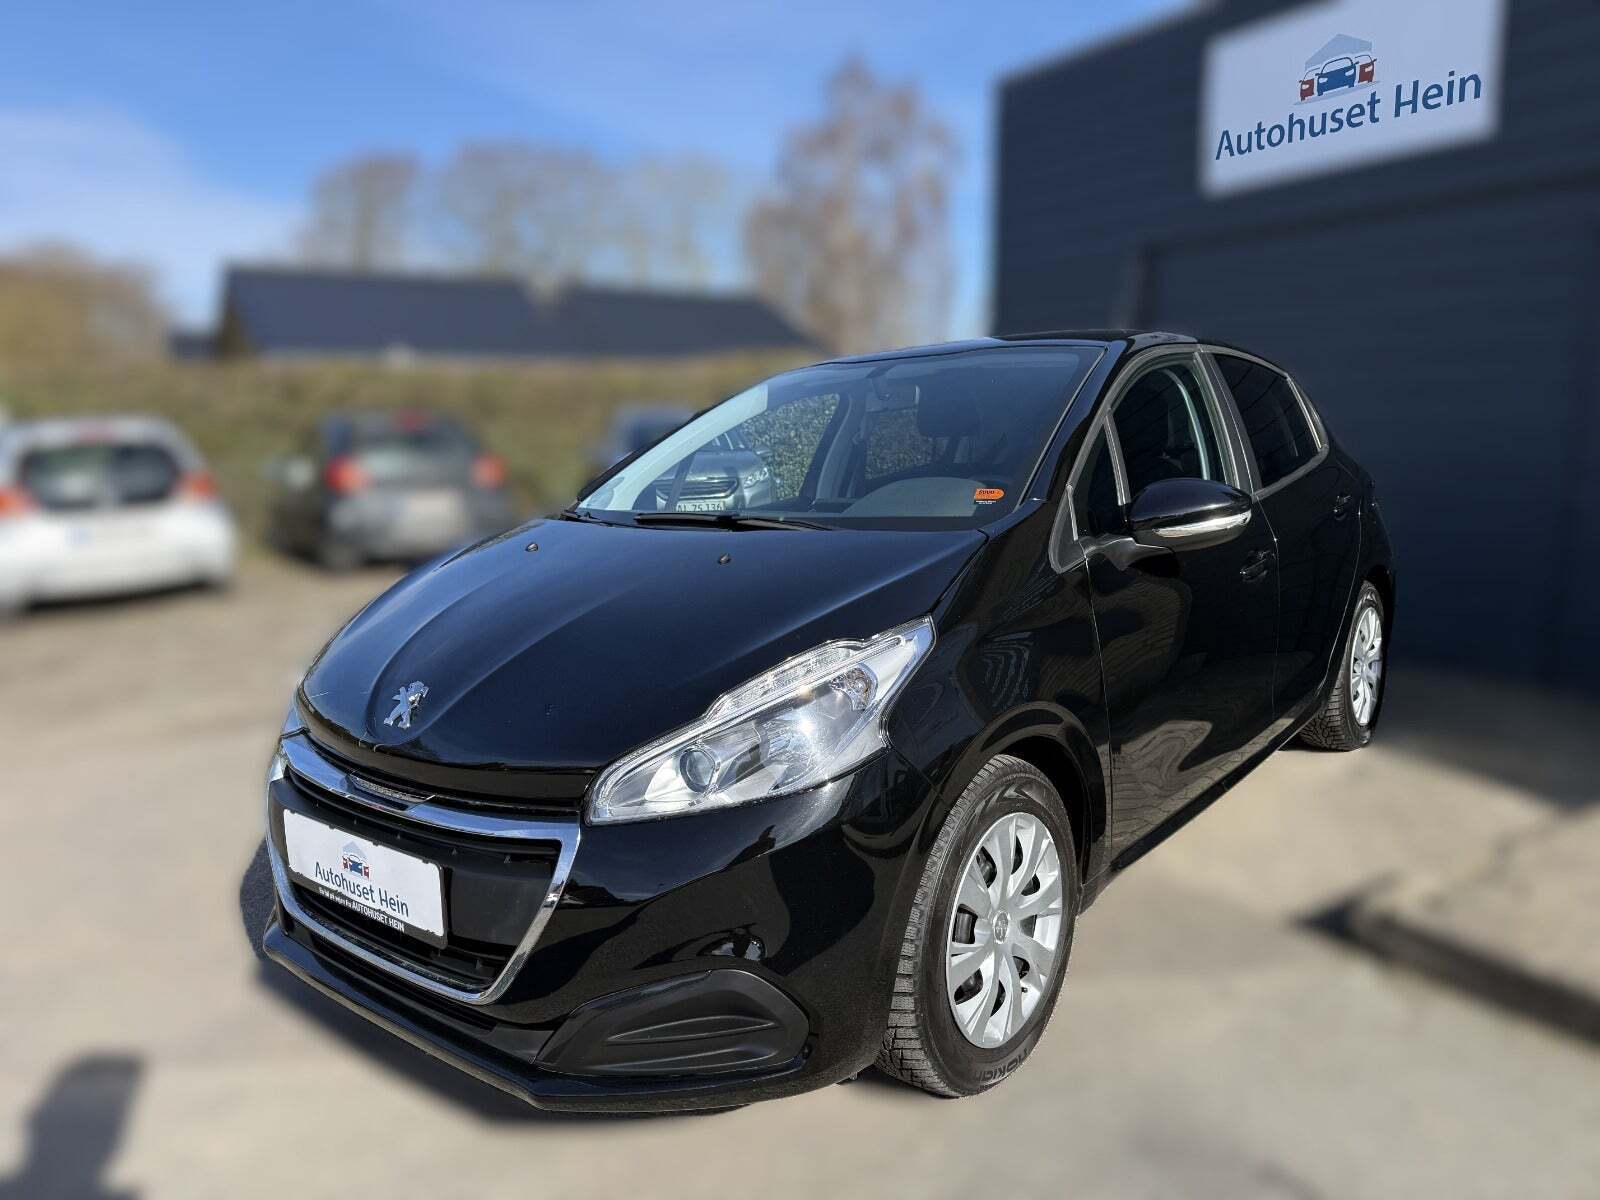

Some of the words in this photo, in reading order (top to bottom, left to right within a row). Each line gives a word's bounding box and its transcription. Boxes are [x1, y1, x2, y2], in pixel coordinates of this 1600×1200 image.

[1215, 90, 1381, 160] Autohuset
[1394, 70, 1482, 118] Hein
[315, 861, 375, 904] Autohuset
[378, 887, 409, 918] Hein
[351, 900, 389, 926] AUTOHUSET
[388, 917, 405, 933] HEIN
